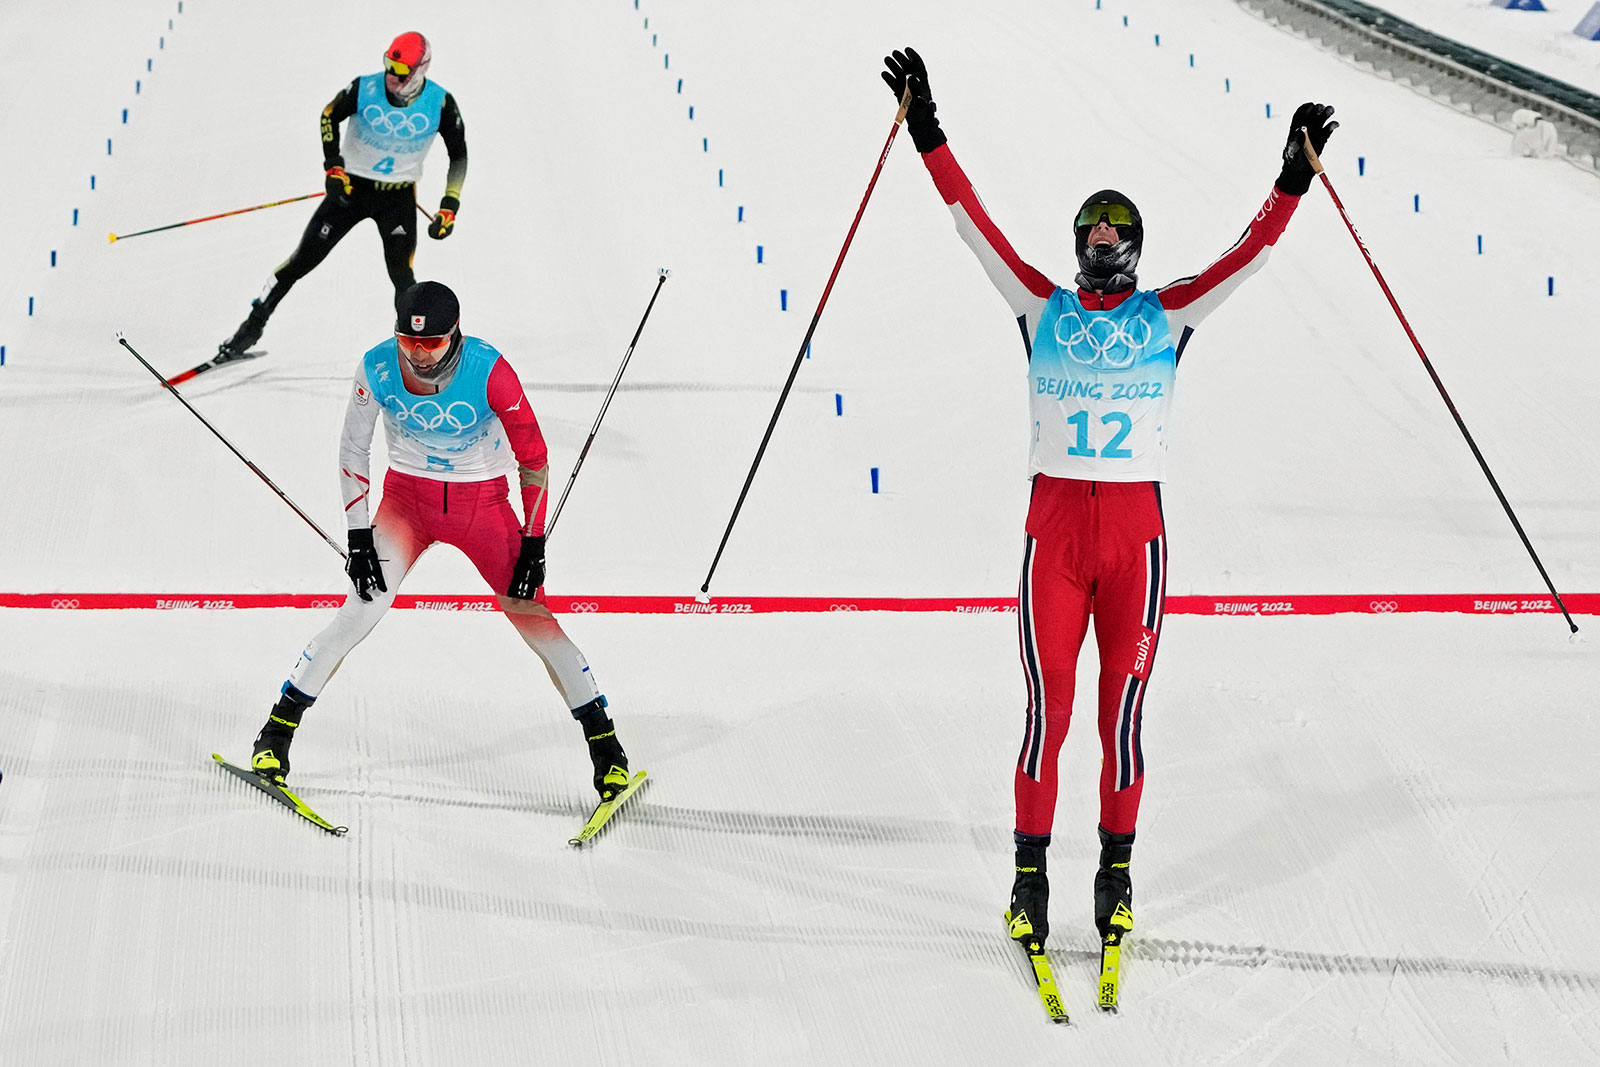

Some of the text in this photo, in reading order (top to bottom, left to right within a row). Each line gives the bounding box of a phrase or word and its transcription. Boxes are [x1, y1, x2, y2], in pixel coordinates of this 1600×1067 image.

[372, 156, 395, 174] 4
[1036, 377, 1163, 400] BEIJING 2022
[1067, 410, 1132, 458] 12
[156, 600, 235, 610] BEIJING 2022
[415, 601, 494, 610] BEIJING 2022
[674, 603, 753, 614] BEIJING 2022
[956, 605, 999, 614] BEIJING
[1214, 602, 1294, 613] BEIJING 2022
[1474, 600, 1554, 612] BEIJING 2022
